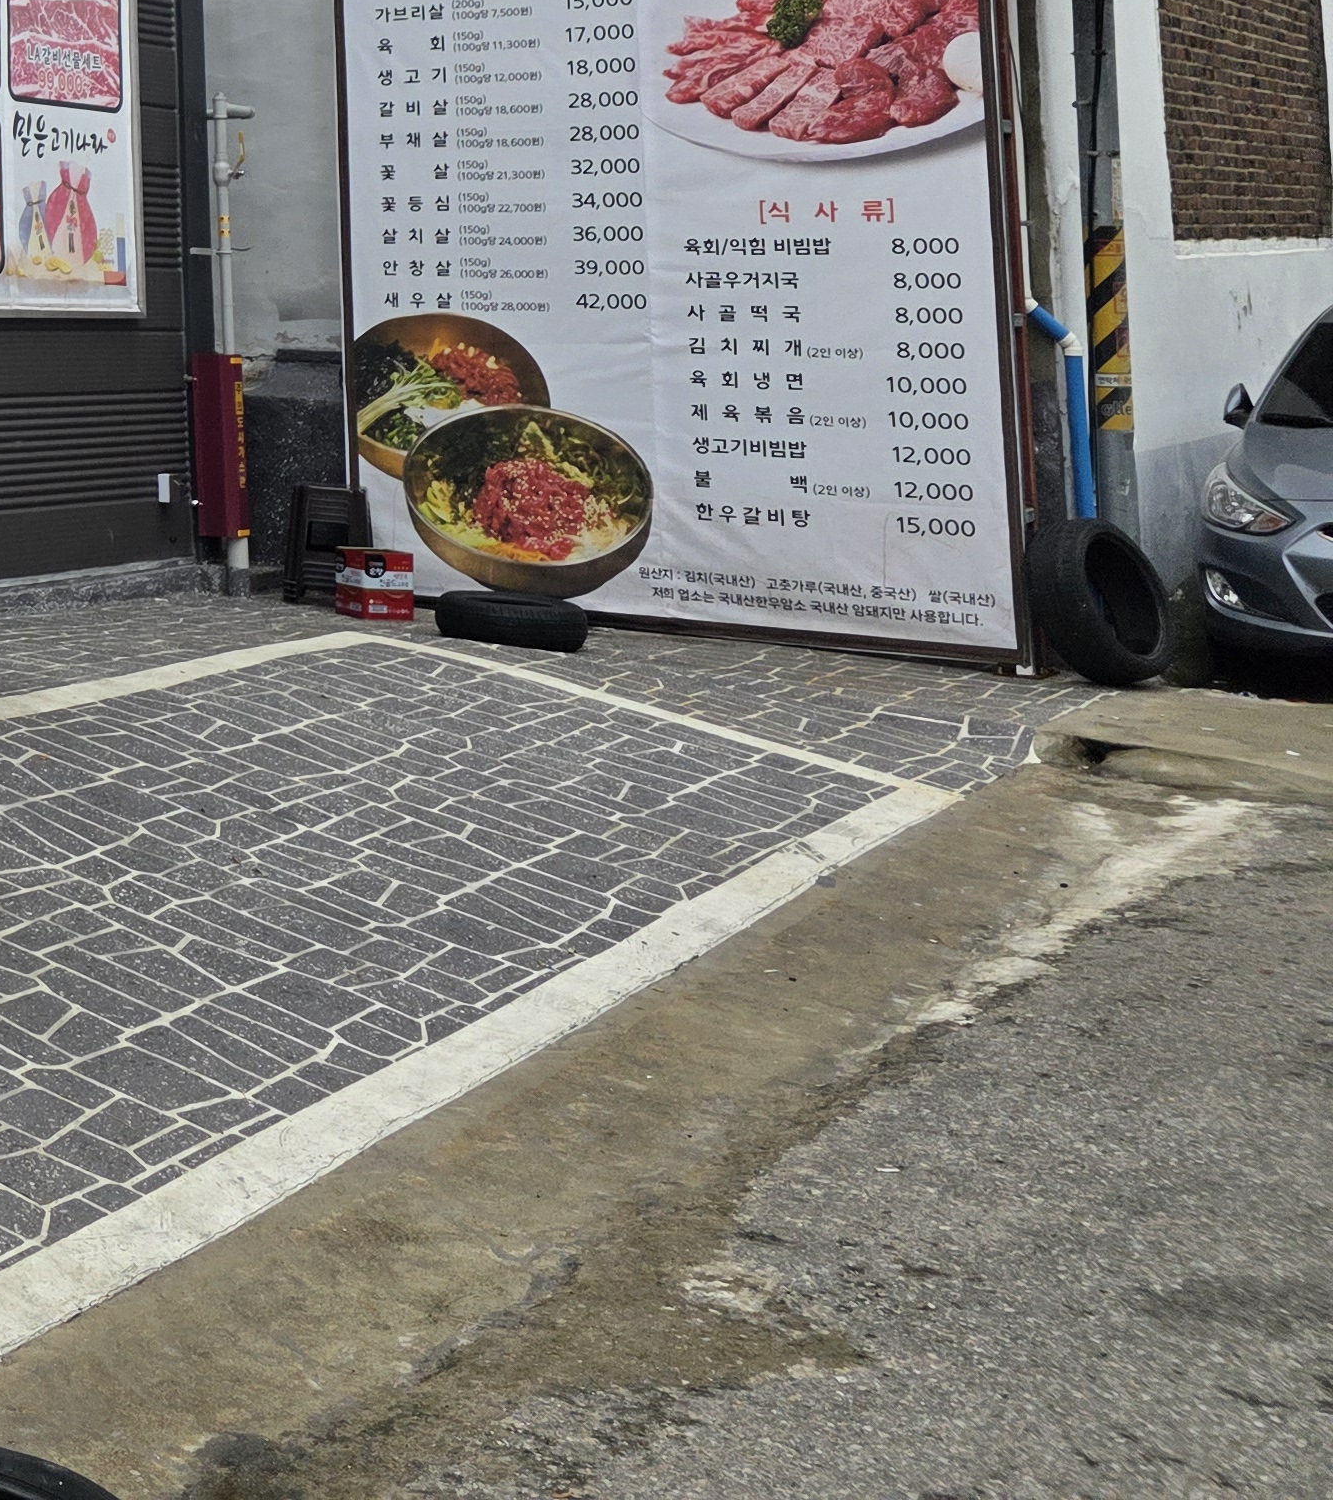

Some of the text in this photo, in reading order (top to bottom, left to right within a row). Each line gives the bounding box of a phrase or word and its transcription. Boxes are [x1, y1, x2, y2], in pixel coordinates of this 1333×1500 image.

[375, 3, 444, 23] 가브리살
[451, 0, 484, 9] (200g)
[453, 31, 484, 41] (150g)
[565, 23, 634, 43] 17,000
[26, 46, 103, 71] LA갈비선물세트
[454, 62, 485, 73] (150g)
[567, 57, 635, 77] 18,000
[37, 72, 92, 95] 99,000~
[455, 95, 486, 105] (150g)
[568, 90, 638, 110] 28,000
[12, 110, 108, 159] 믿음고기나라
[456, 127, 487, 138] (150g)
[569, 124, 640, 143] 28,000
[457, 159, 488, 170] (150g)
[570, 158, 640, 177] 32,000
[458, 192, 489, 202] (150g)
[572, 191, 643, 210] 34,000
[459, 224, 490, 235] (150g)
[573, 225, 643, 244] 36,000
[683, 237, 832, 256] 육회/익힘 비빔밥
[891, 237, 960, 257] 8,000
[460, 257, 491, 268] (150g)
[574, 259, 645, 277] 39,000
[685, 271, 799, 289] 사골우거지국
[893, 272, 962, 291] 8,000
[461, 290, 492, 300] (150g)
[576, 293, 647, 311] 42,000
[895, 307, 964, 326] 8,000
[835, 347, 864, 360] 이상)
[896, 341, 965, 361] 8,000
[886, 376, 967, 396] 10,000
[838, 416, 867, 429] 이상)
[888, 411, 969, 431] 10,000
[692, 436, 807, 459] 생고기비빔밥
[892, 446, 971, 466] 12,000
[841, 485, 870, 498] 이상)
[894, 481, 973, 502] 12,000
[896, 516, 976, 538] 15,000
[638, 565, 674, 580] 원산지
[684, 569, 756, 589] 김치(국내산)
[870, 585, 917, 602] 중국산)
[928, 589, 996, 608] 쌀(국내산)
[651, 586, 675, 600] 저희
[678, 588, 715, 604] 업소는
[809, 600, 849, 617] 국내산
[852, 603, 906, 622] 암돼지만
[909, 609, 984, 627] 사용합니다.
